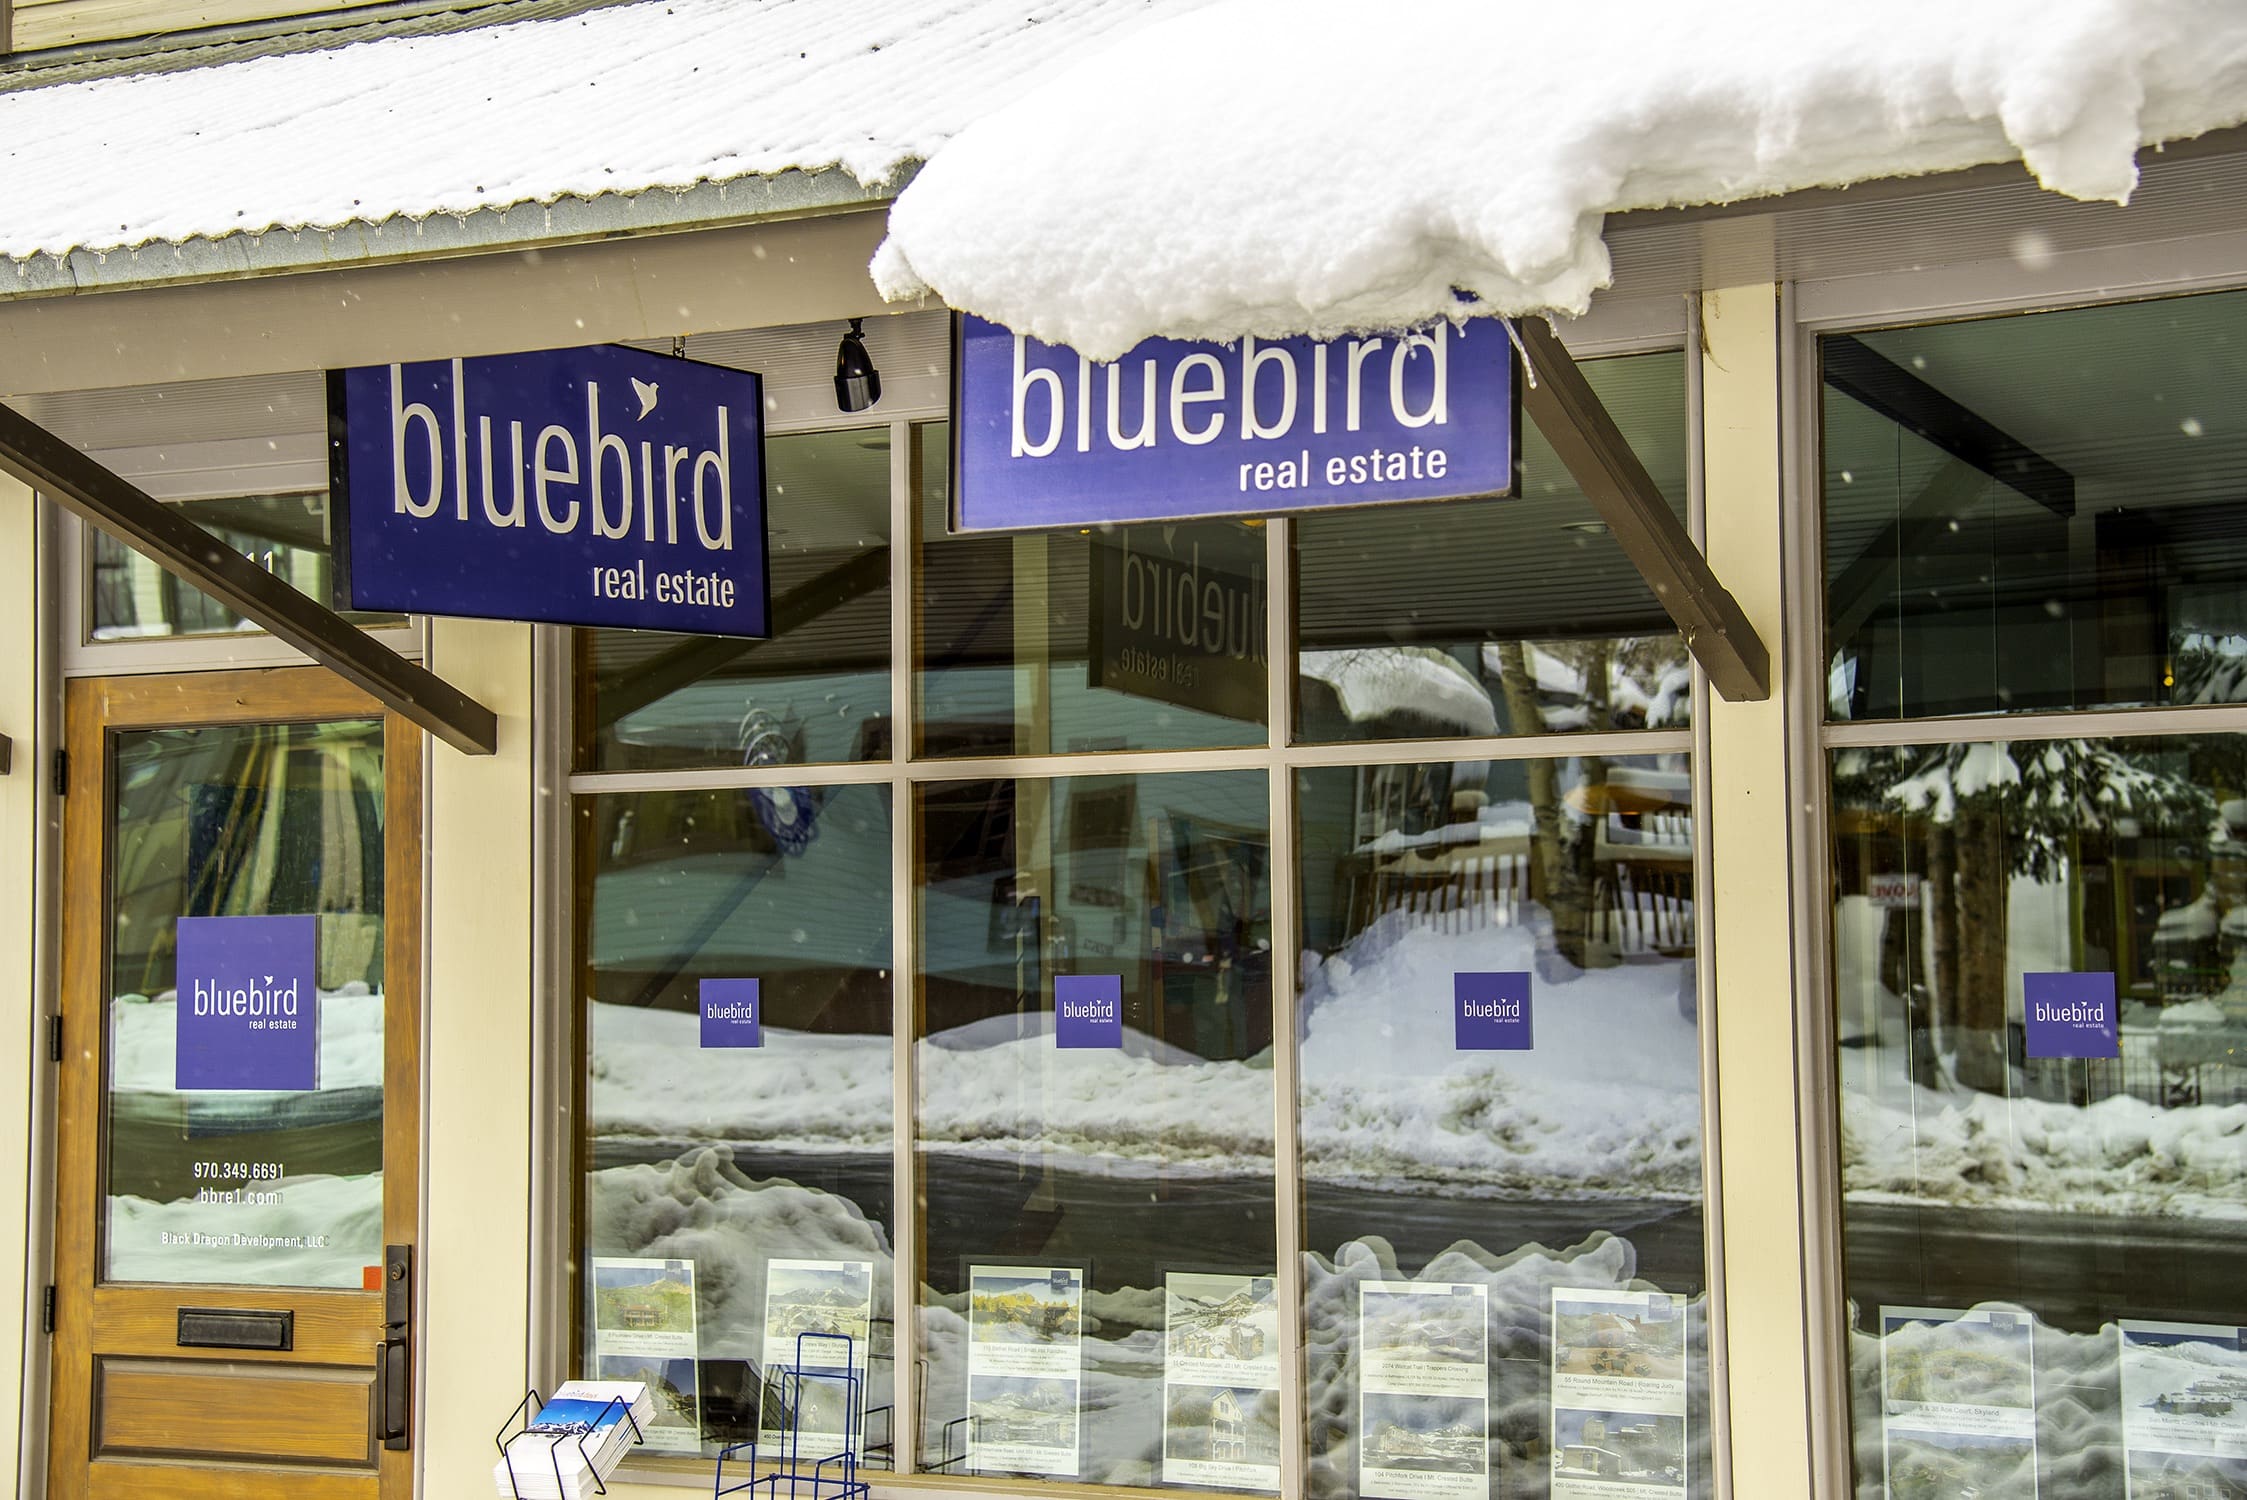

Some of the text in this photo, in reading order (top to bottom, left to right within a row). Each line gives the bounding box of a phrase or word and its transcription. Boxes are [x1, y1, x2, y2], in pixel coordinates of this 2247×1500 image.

[1011, 319, 1447, 458] bluebird
[390, 358, 733, 550] bluebird
[1240, 447, 1447, 491] real estate
[593, 560, 735, 608] real estate
[194, 976, 297, 1016] bluebird
[707, 1001, 752, 1019] bluebird
[1063, 1000, 1113, 1018] bluebird
[1464, 998, 1520, 1017] bluebird
[2035, 1001, 2104, 1022] bluebird
[249, 1018, 297, 1030] real estate
[194, 1162, 284, 1179] 970.349.6691
[200, 1187, 278, 1205] bbre1.com
[161, 1232, 325, 1249] Black Dragon Development, LLC
